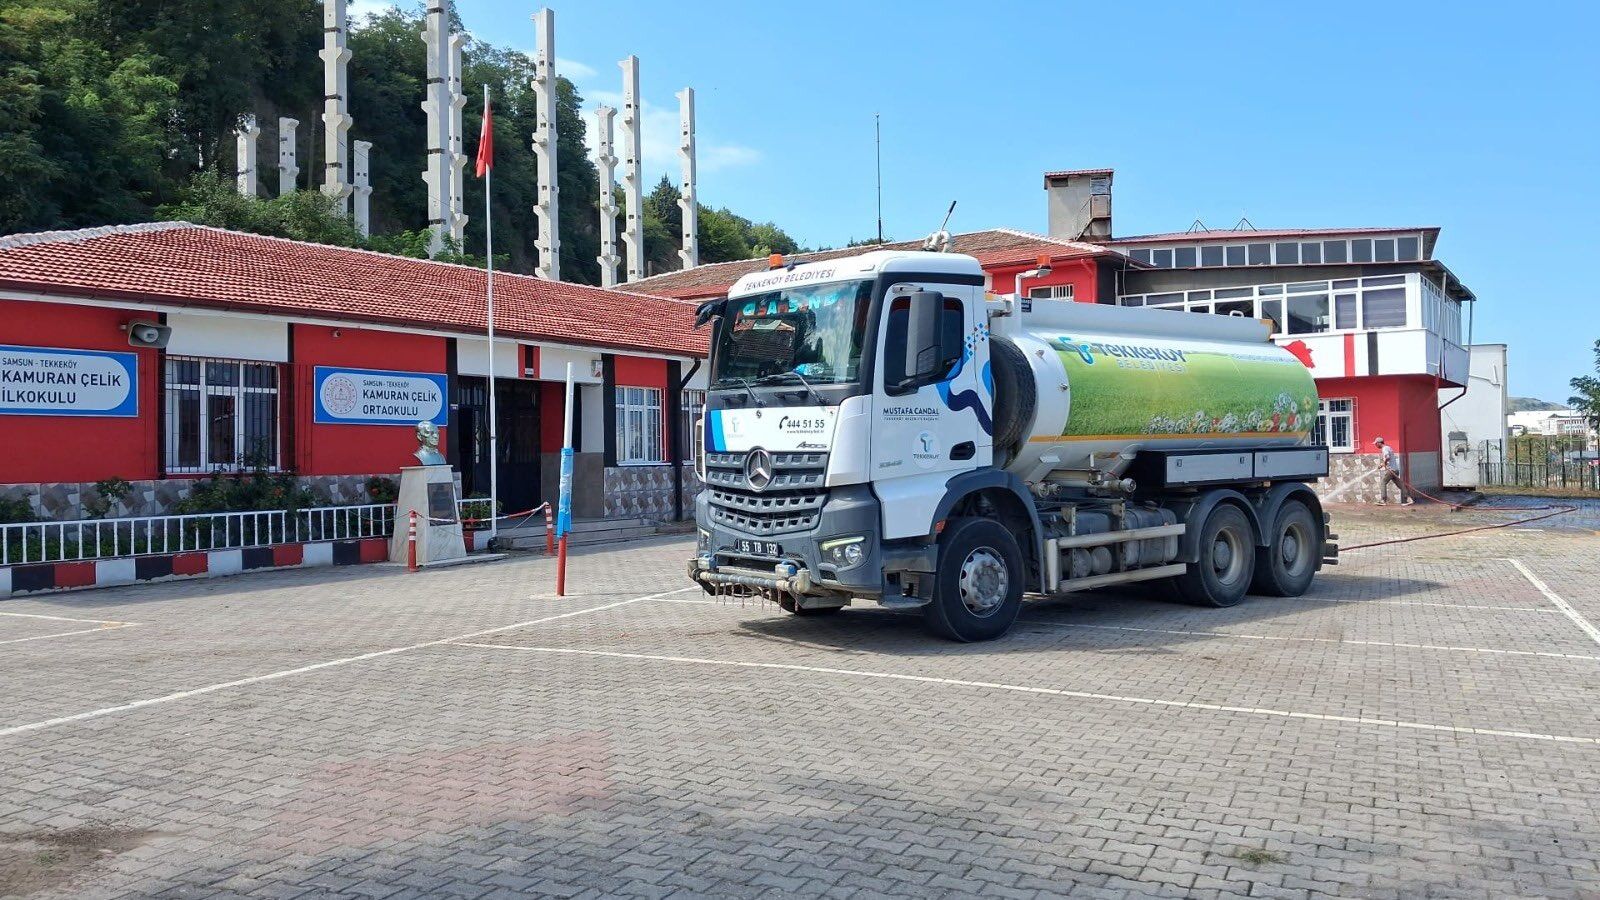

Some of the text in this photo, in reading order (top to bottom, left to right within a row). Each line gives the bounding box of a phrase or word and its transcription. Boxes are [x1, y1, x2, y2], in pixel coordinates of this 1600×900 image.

[2, 357, 33, 367] SAMSUN
[2, 370, 121, 387] KAMURAN ÇELİK
[2, 386, 76, 404] İLKOKULU
[363, 389, 437, 402] KAMURAN ÇELİK
[363, 404, 418, 416] ORTAOKULU
[883, 407, 939, 415] MUSTAFA CANDAL
[786, 419, 825, 428] 444 51 55
[742, 541, 750, 552] 55
